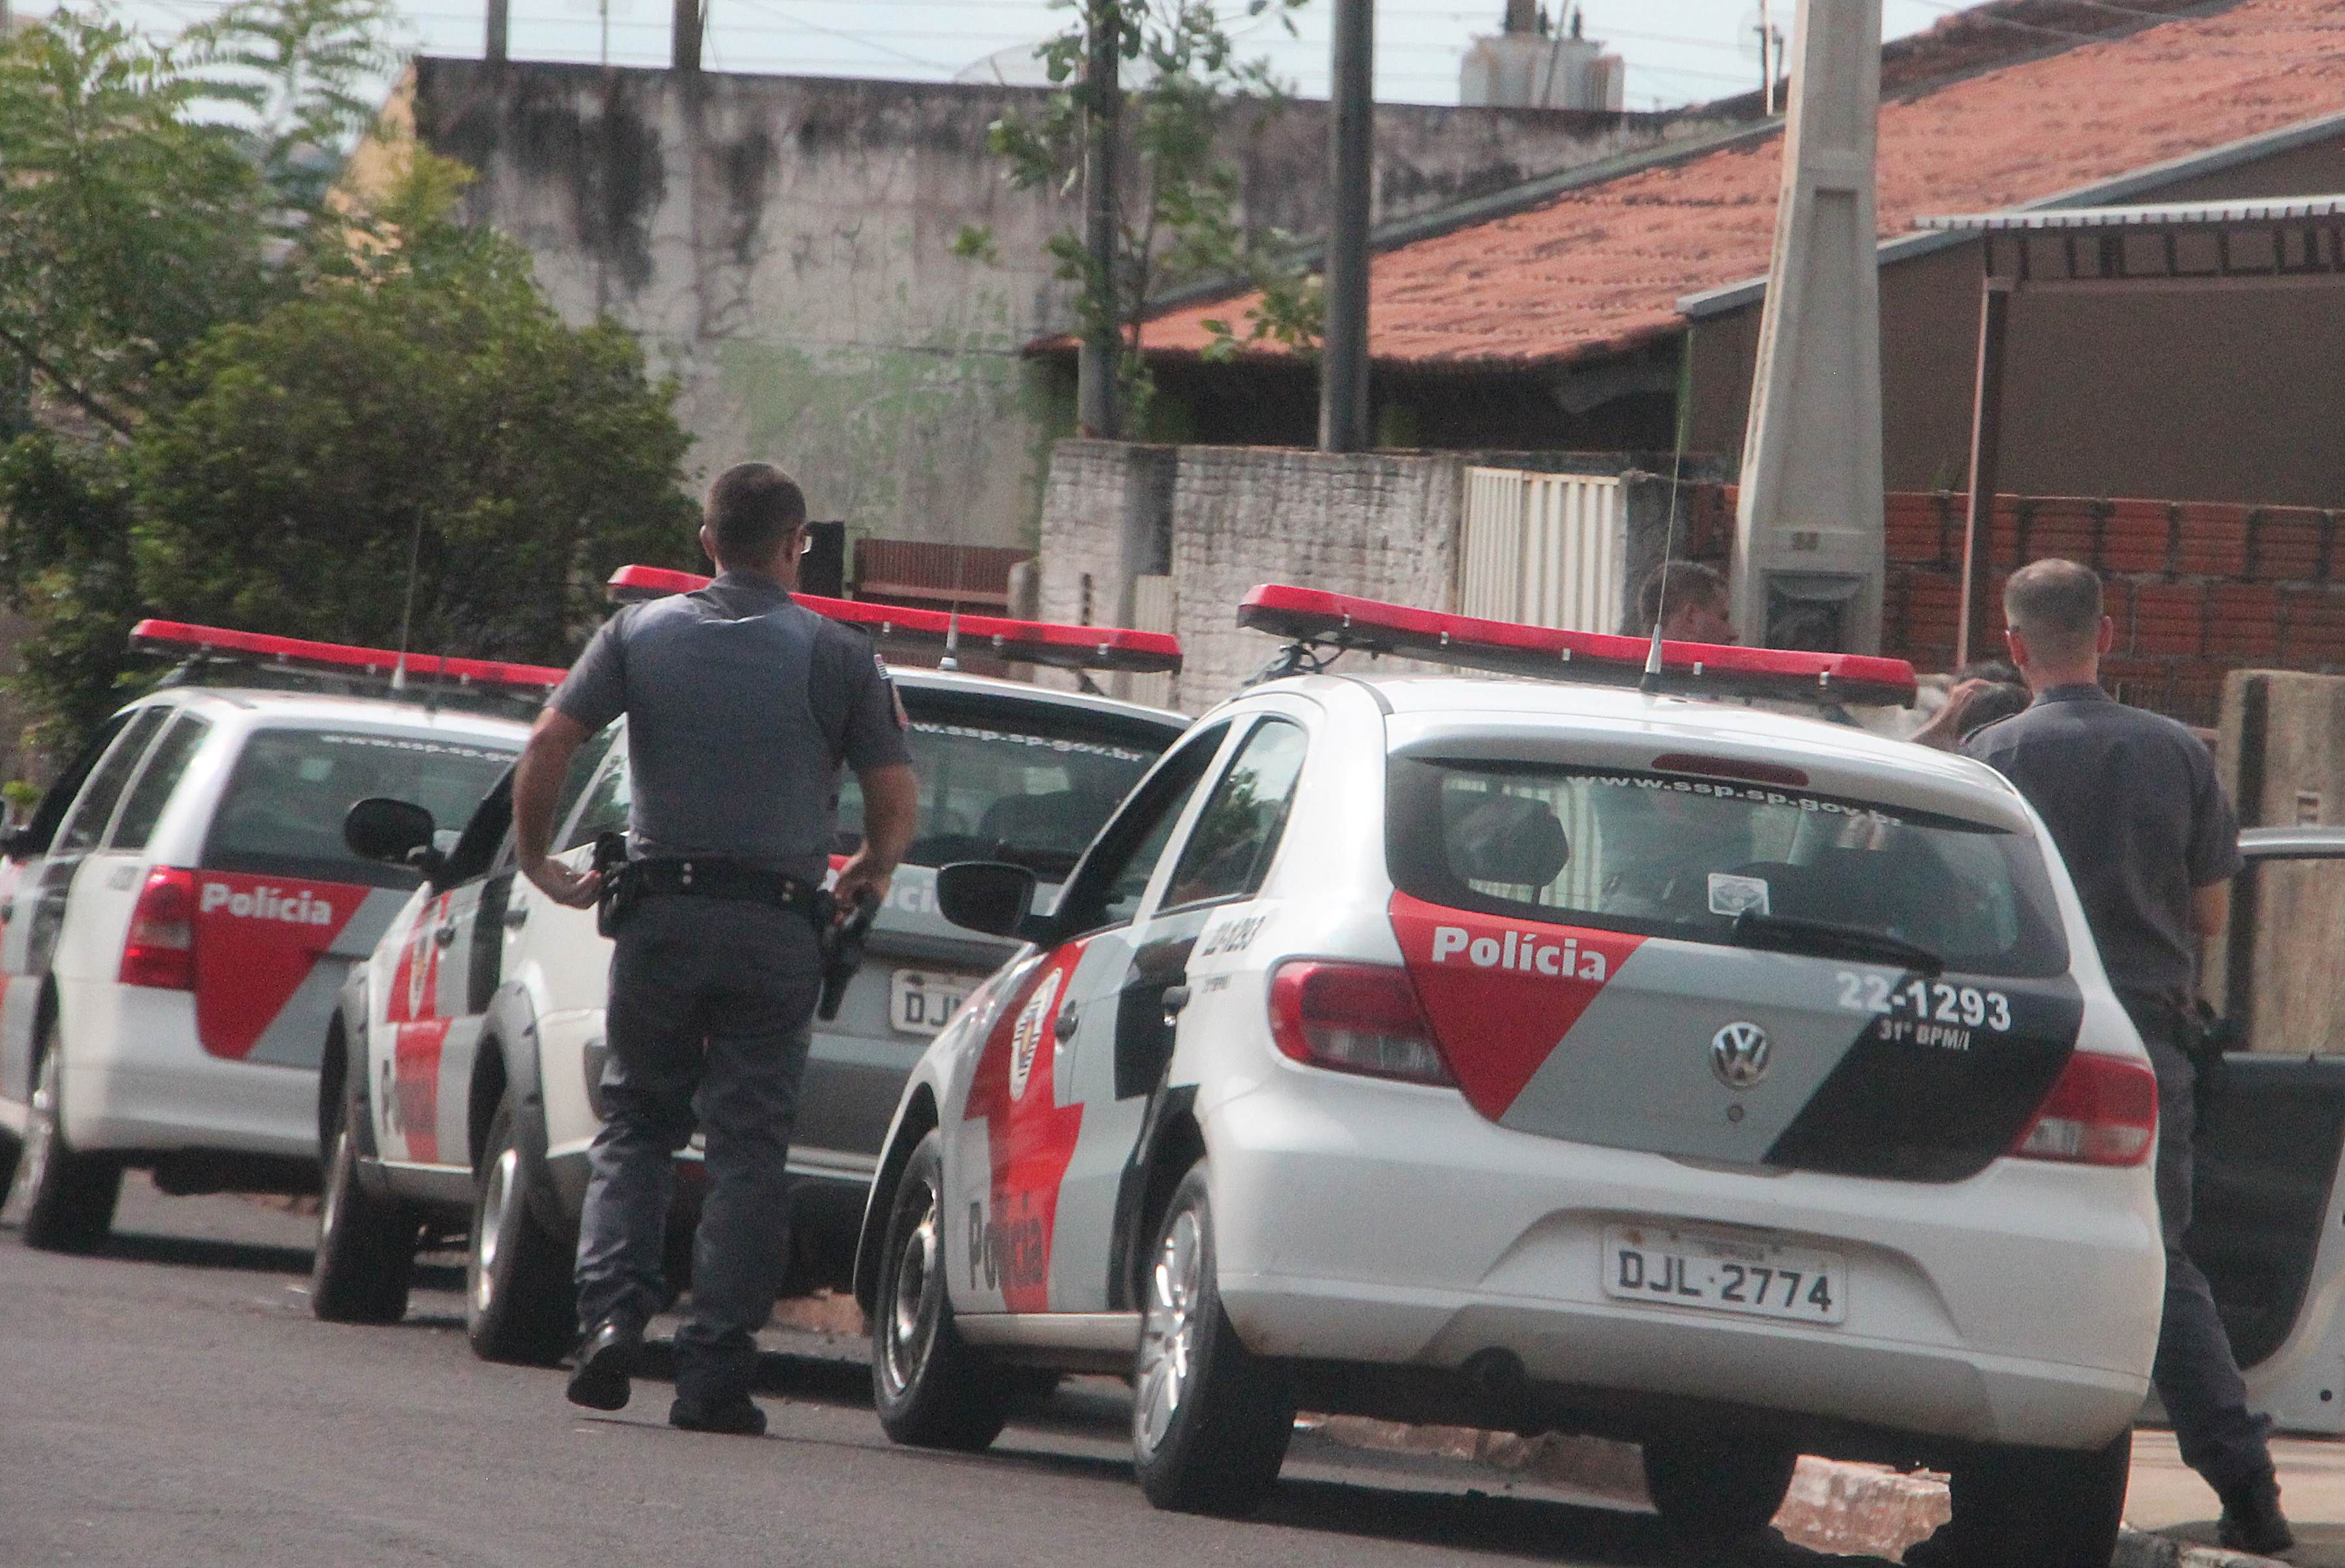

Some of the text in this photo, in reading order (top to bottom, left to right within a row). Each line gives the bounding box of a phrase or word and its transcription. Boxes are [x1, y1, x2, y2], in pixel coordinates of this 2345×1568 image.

[199, 883, 332, 926] Polícia
[1432, 925, 1608, 982] Polícia
[1836, 971, 2012, 1032] 22-1293
